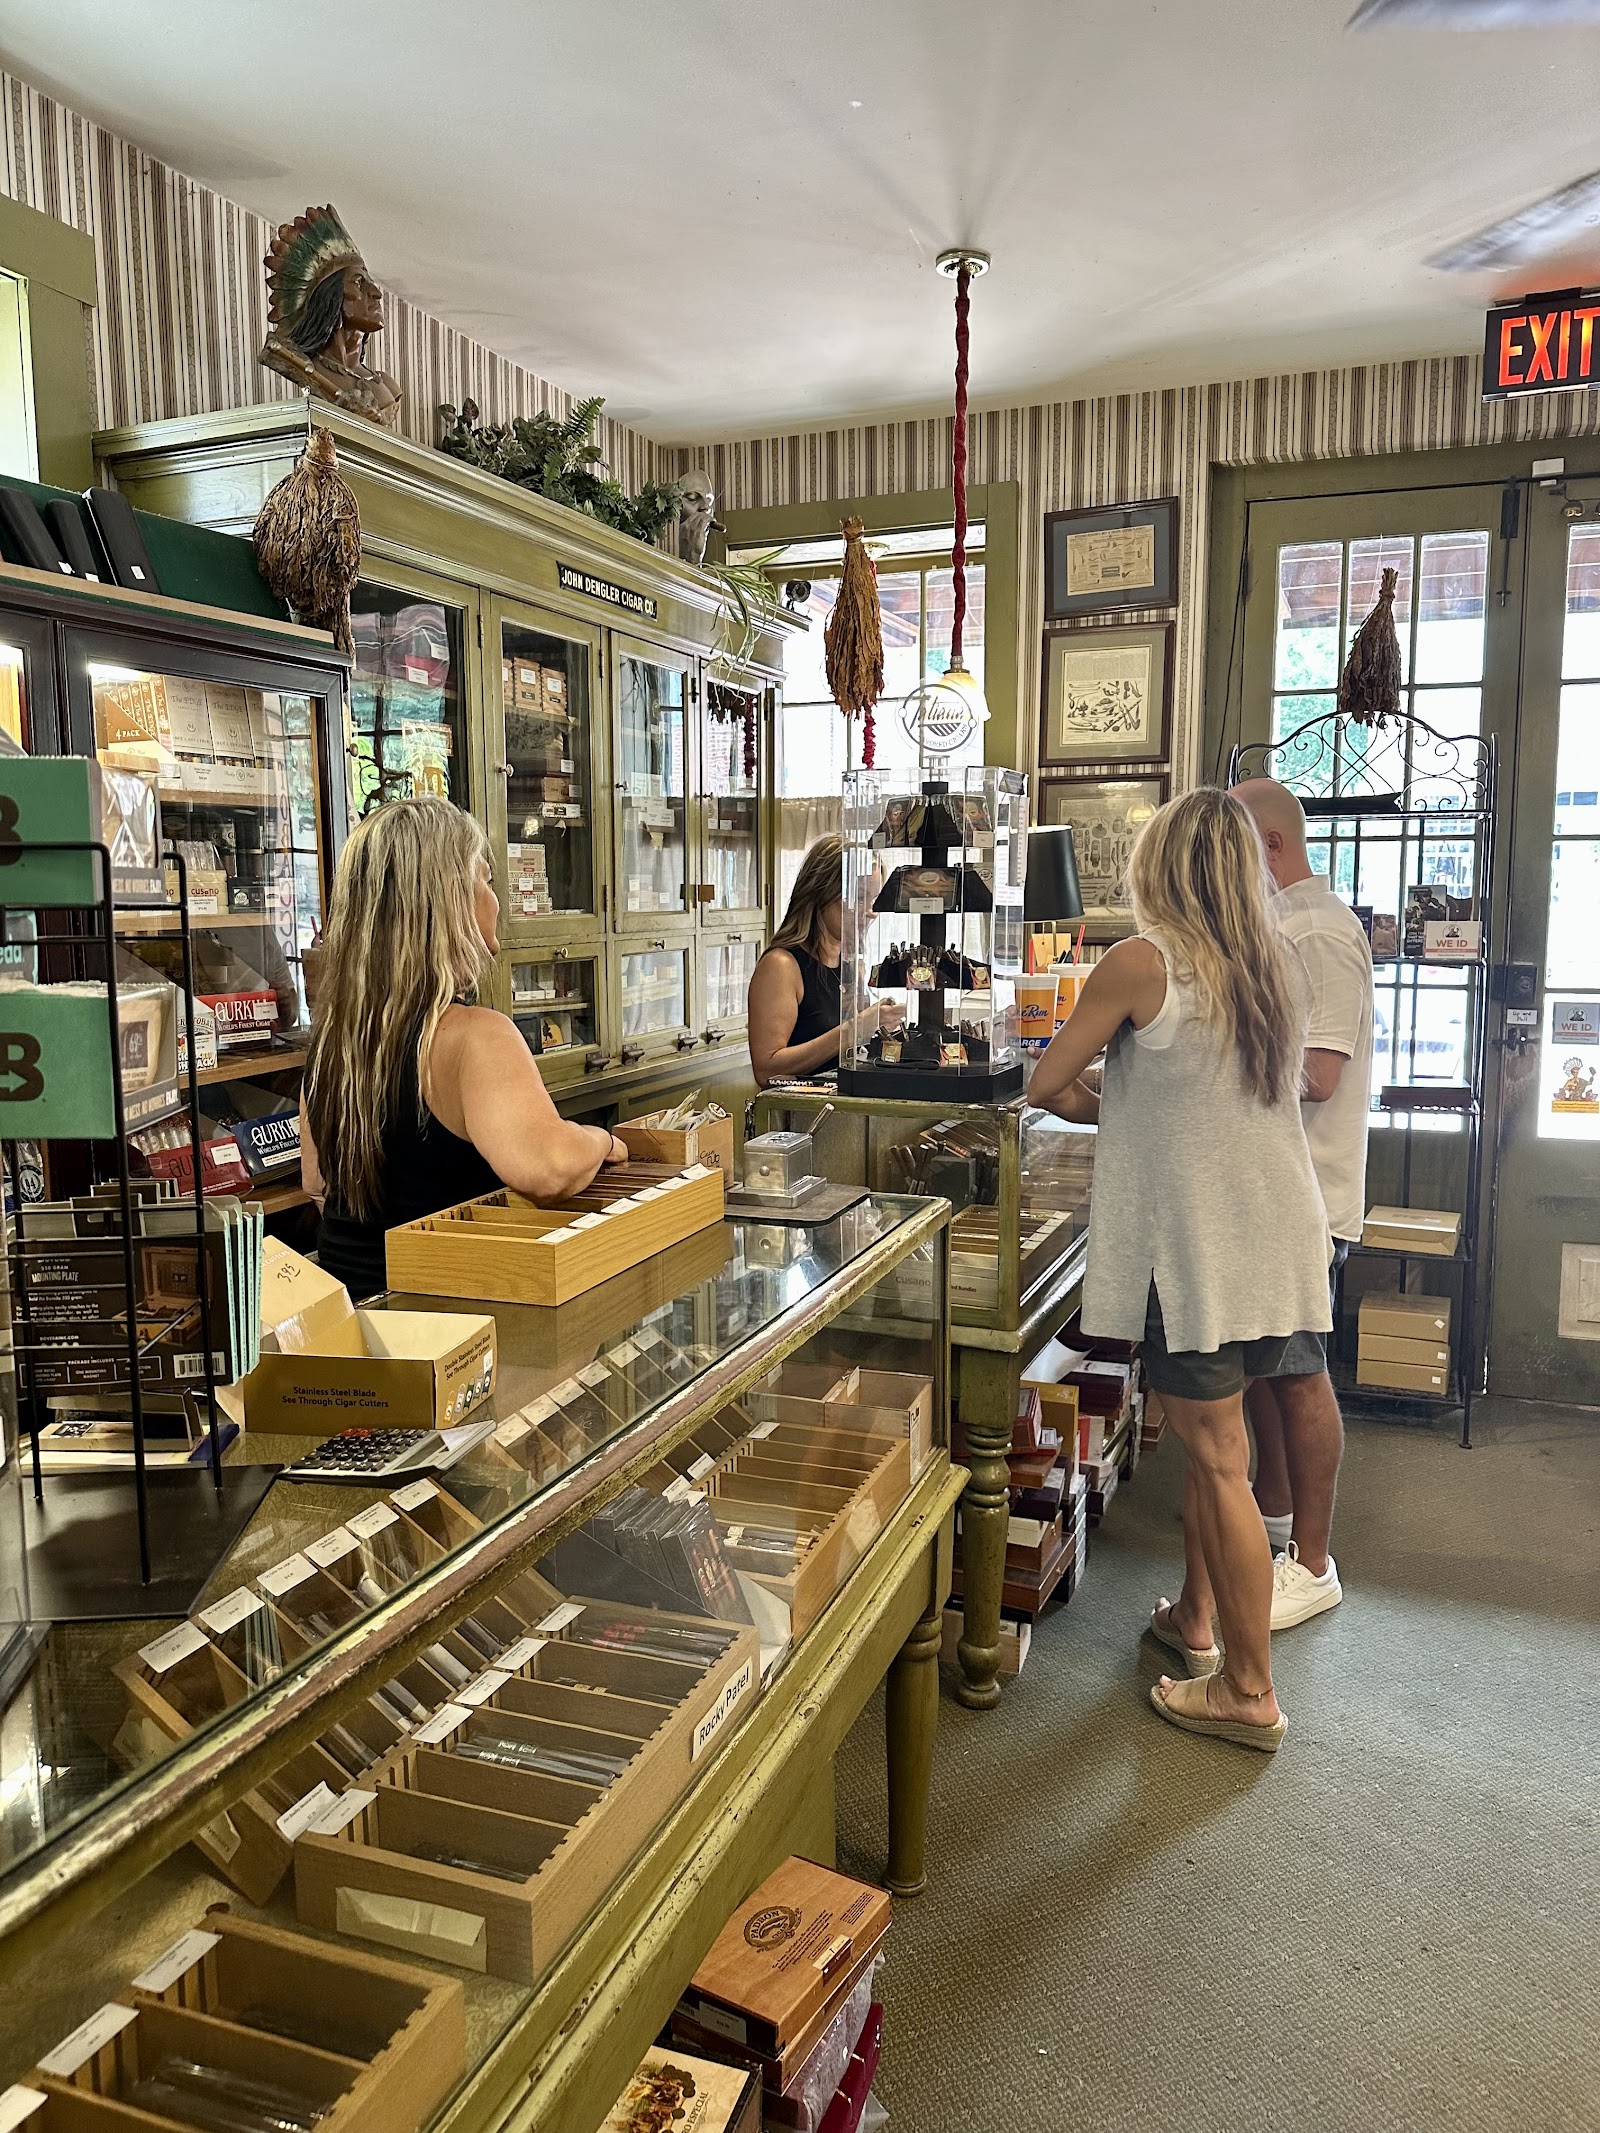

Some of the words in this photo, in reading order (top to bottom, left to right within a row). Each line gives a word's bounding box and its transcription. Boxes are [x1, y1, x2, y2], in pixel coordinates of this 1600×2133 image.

[1499, 307, 1600, 386] EXIT
[562, 569, 583, 589] JOHN
[585, 577, 620, 603] DENGLER
[621, 591, 643, 612] CIGAR
[645, 600, 655, 615] CO.
[116, 729, 121, 740] 4
[1562, 1023, 1577, 1031] WE
[32, 1271, 61, 1283] MOUNTING
[62, 1272, 79, 1282] PLATE
[293, 1387, 328, 1395] Stainless
[353, 1389, 376, 1397] Blade
[298, 1396, 333, 1407] Through
[335, 1399, 356, 1408] Cigar
[359, 1399, 389, 1407] Cutters
[699, 1701, 725, 1745] Rocky
[726, 1666, 749, 1707] Patel
[689, 2091, 709, 2125] ESPECIAL
